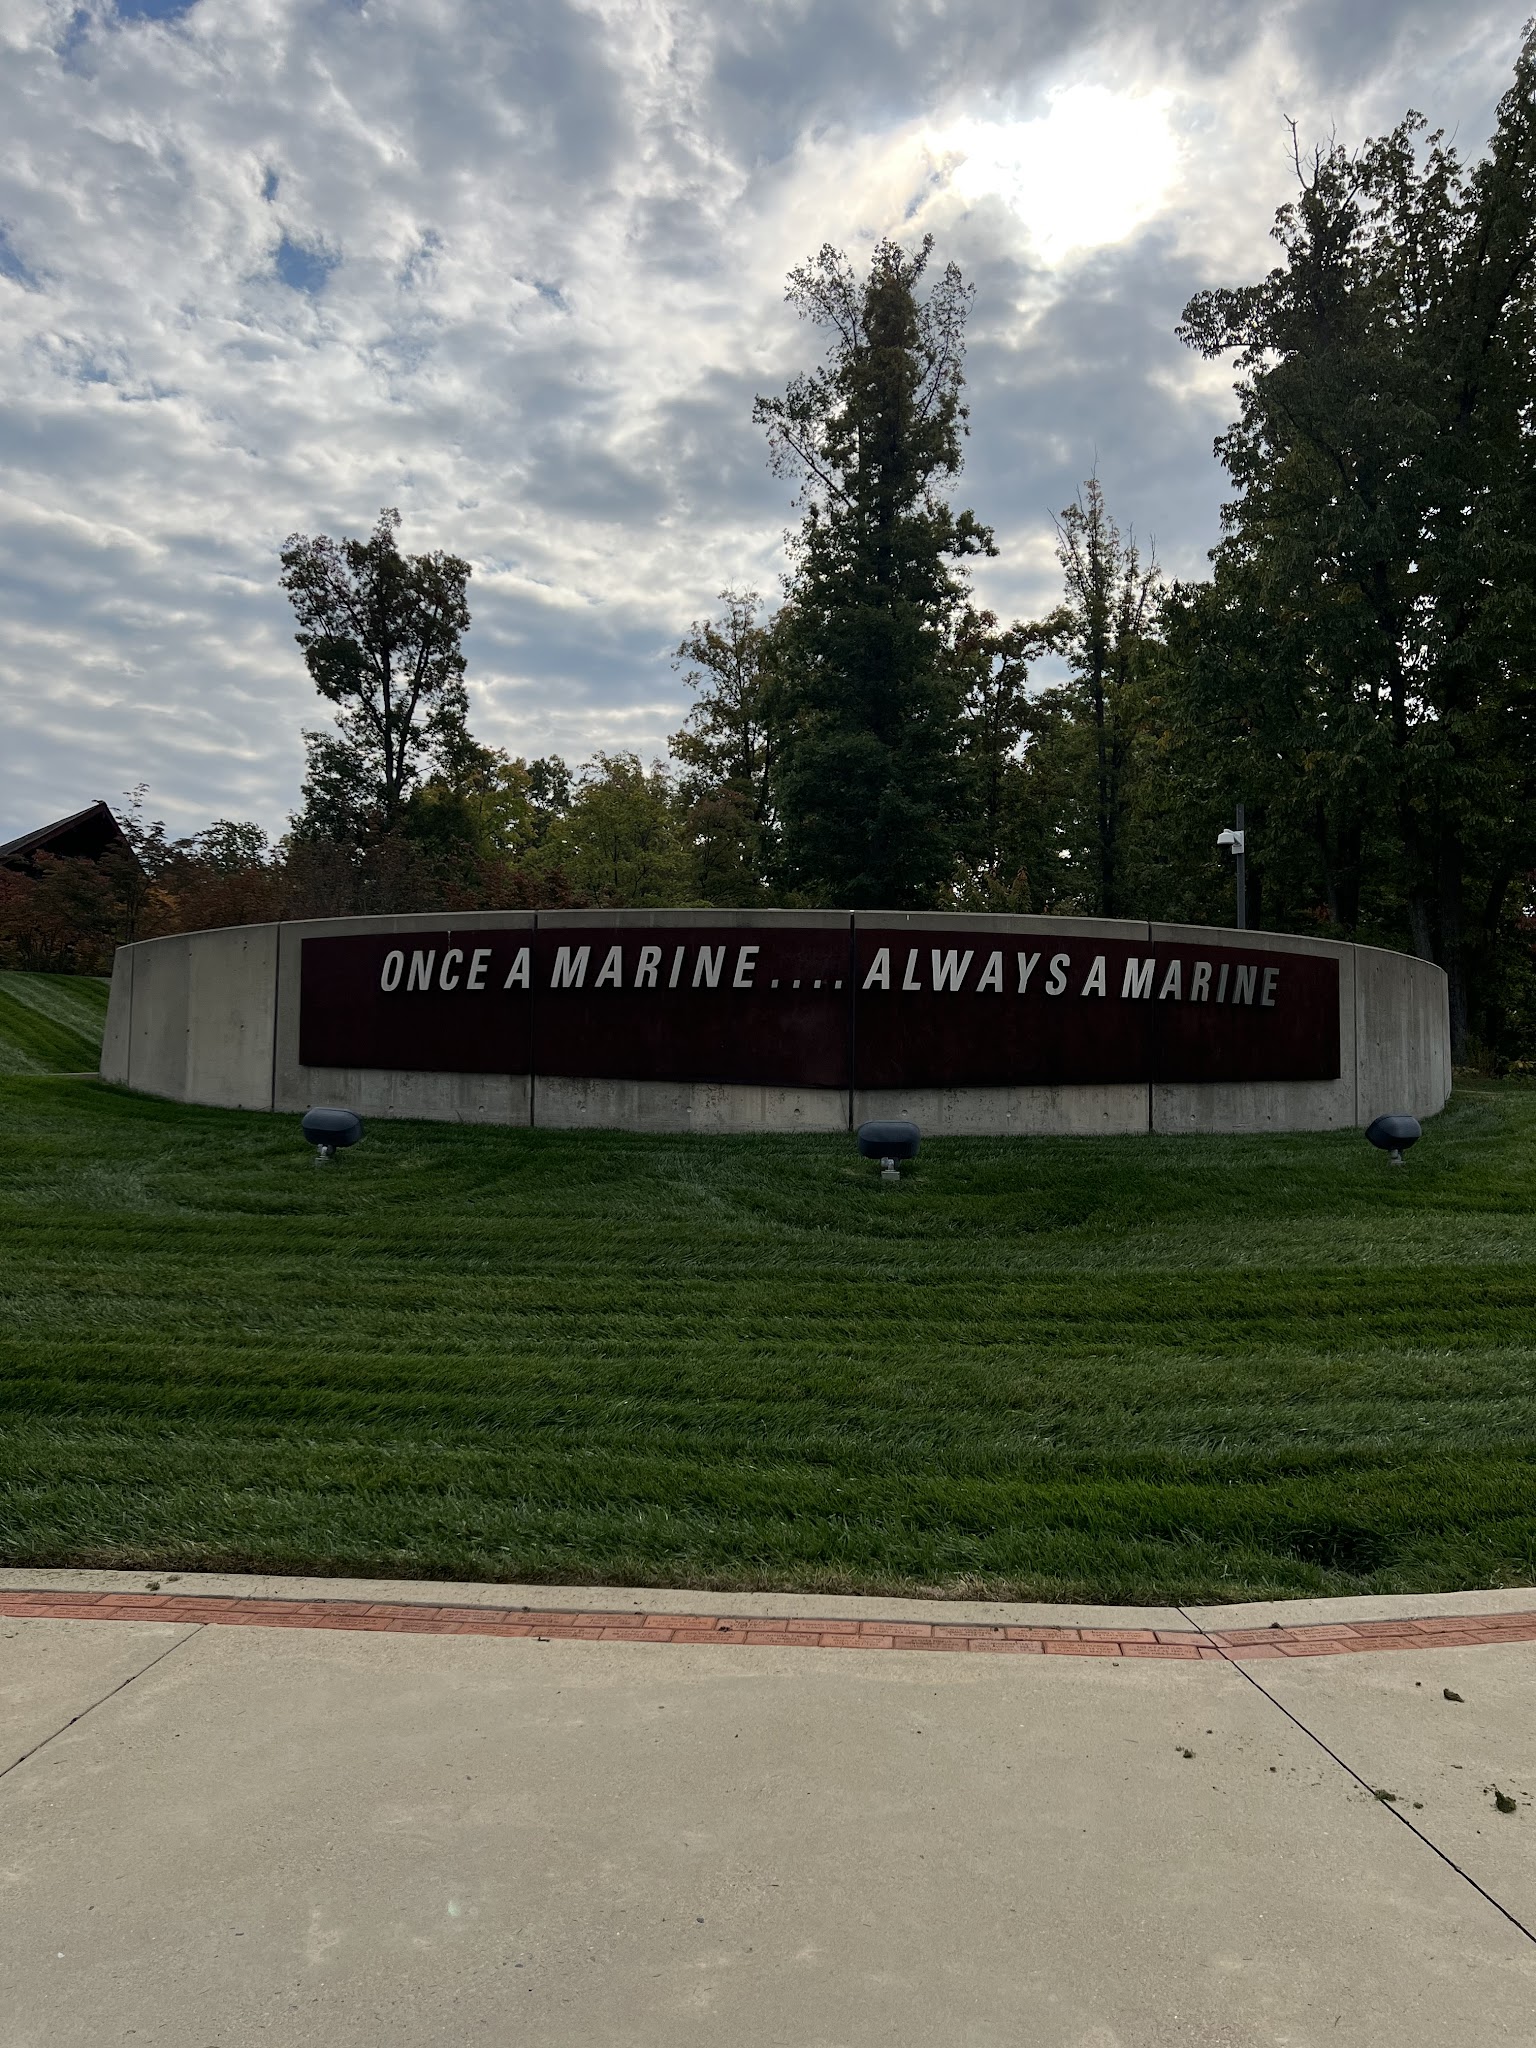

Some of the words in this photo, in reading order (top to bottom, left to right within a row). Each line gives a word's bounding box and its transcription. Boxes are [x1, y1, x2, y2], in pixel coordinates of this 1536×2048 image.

[380, 948, 493, 992] ONCE
[503, 947, 531, 989] A
[861, 948, 1071, 996] ALWAYS
[1081, 955, 1107, 997] A
[1121, 957, 1281, 1007] MARINE
